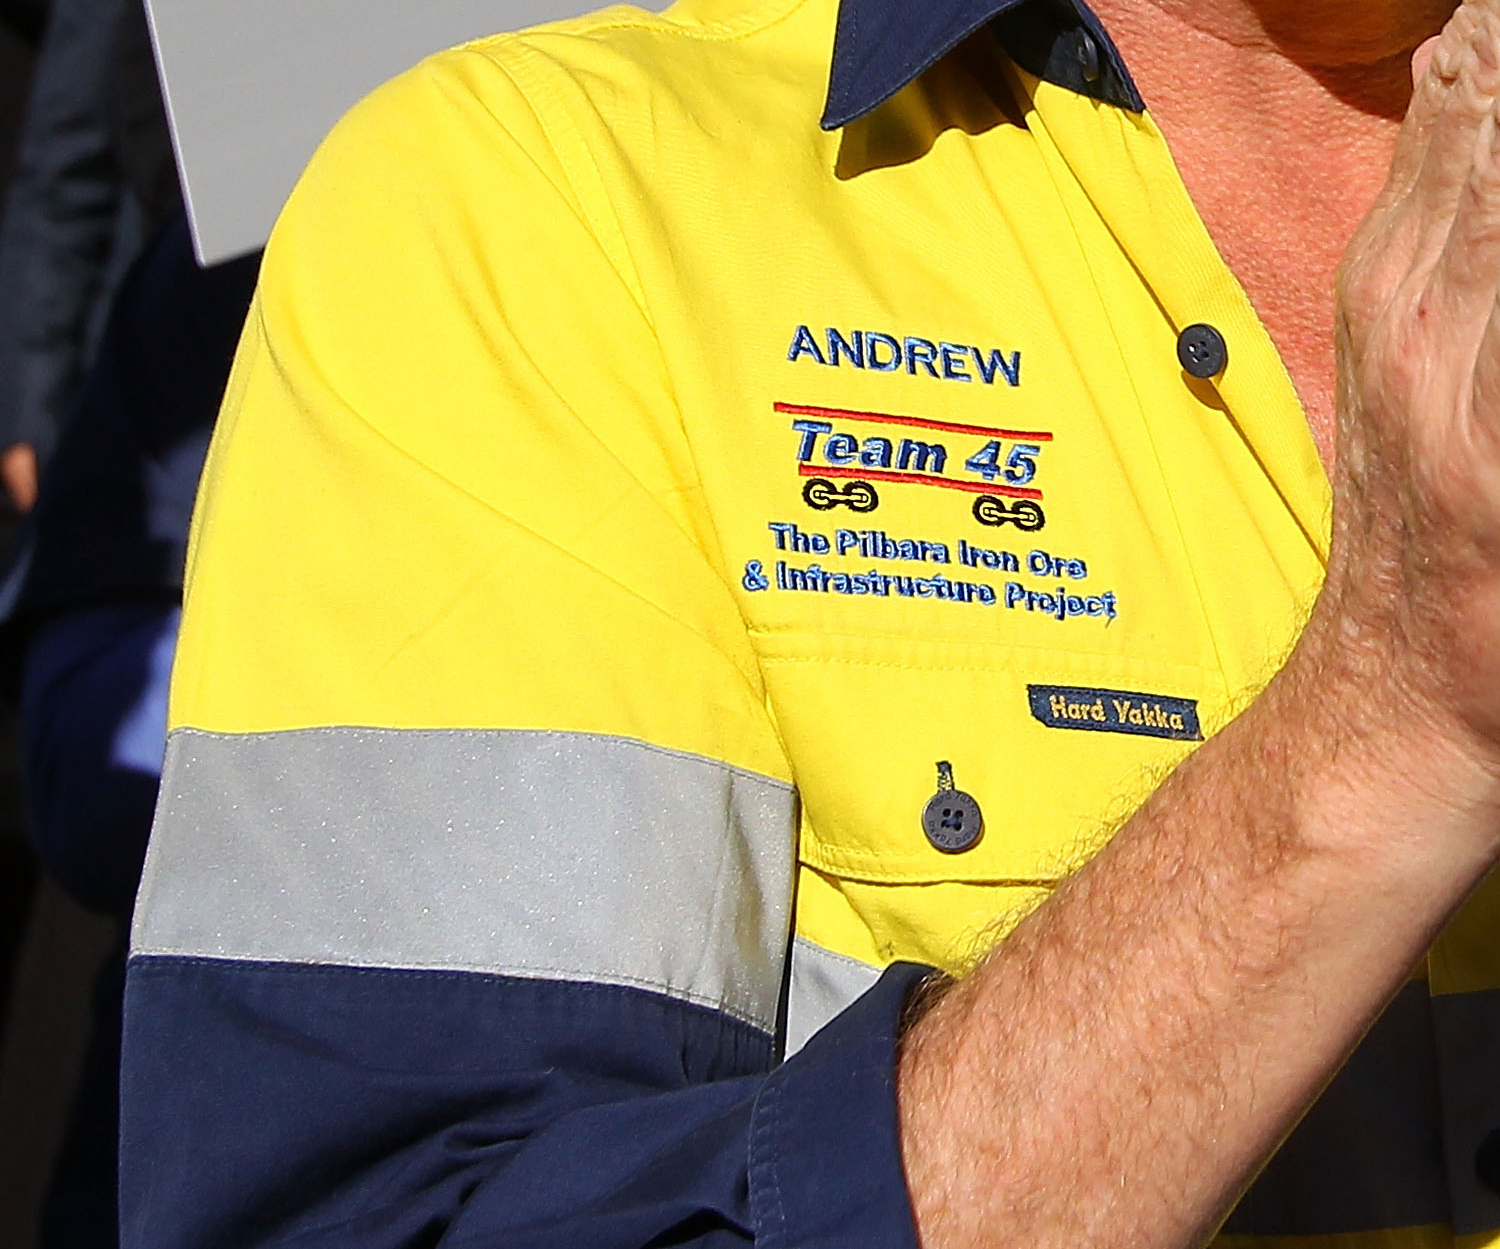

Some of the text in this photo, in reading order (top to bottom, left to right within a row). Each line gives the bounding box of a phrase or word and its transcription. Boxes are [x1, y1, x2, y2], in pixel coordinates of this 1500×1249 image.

[787, 325, 1022, 387] ANDREW
[792, 419, 1041, 485] Team 45
[768, 522, 1088, 581] The Pilbara Iron Ore
[742, 559, 1118, 622] & Infrastructure Project
[1049, 694, 1185, 731] Hard Yakka
